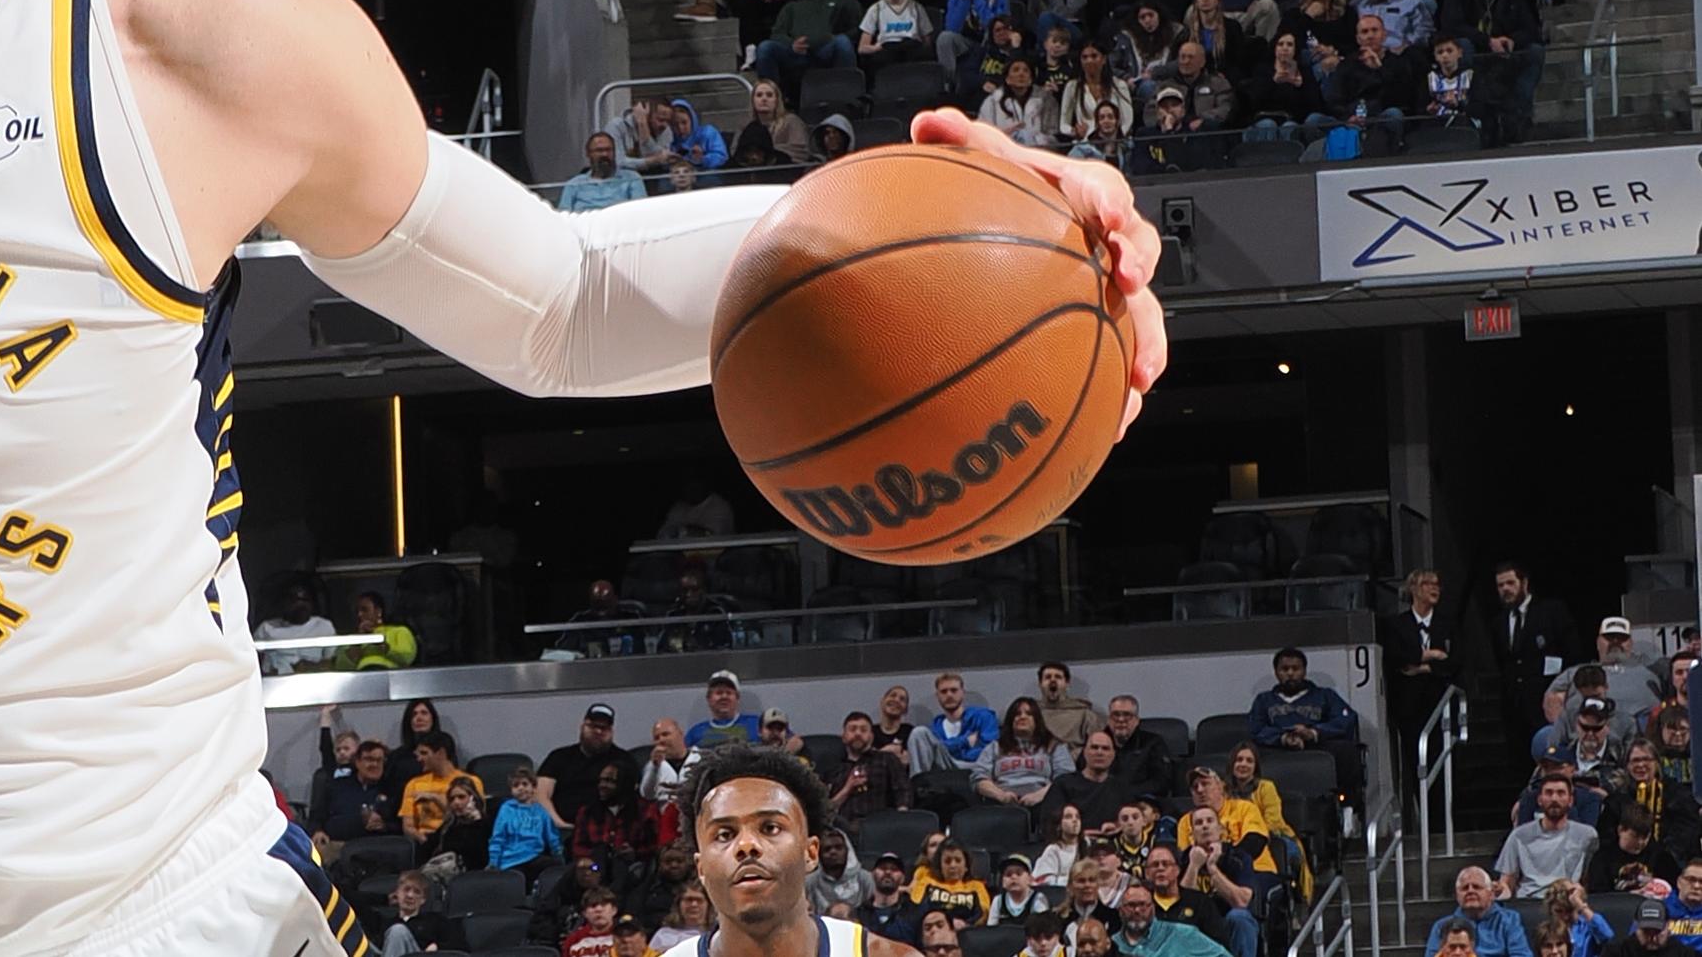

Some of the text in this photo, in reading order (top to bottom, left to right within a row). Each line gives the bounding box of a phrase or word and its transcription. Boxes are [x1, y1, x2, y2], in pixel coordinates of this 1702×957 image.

[5, 116, 44, 142] OIL
[1486, 180, 1655, 224] XIBER
[1510, 211, 1652, 245] INTERNET
[1473, 305, 1513, 334] EXIT
[779, 399, 1051, 538] Wilson
[1354, 644, 1370, 688] 9
